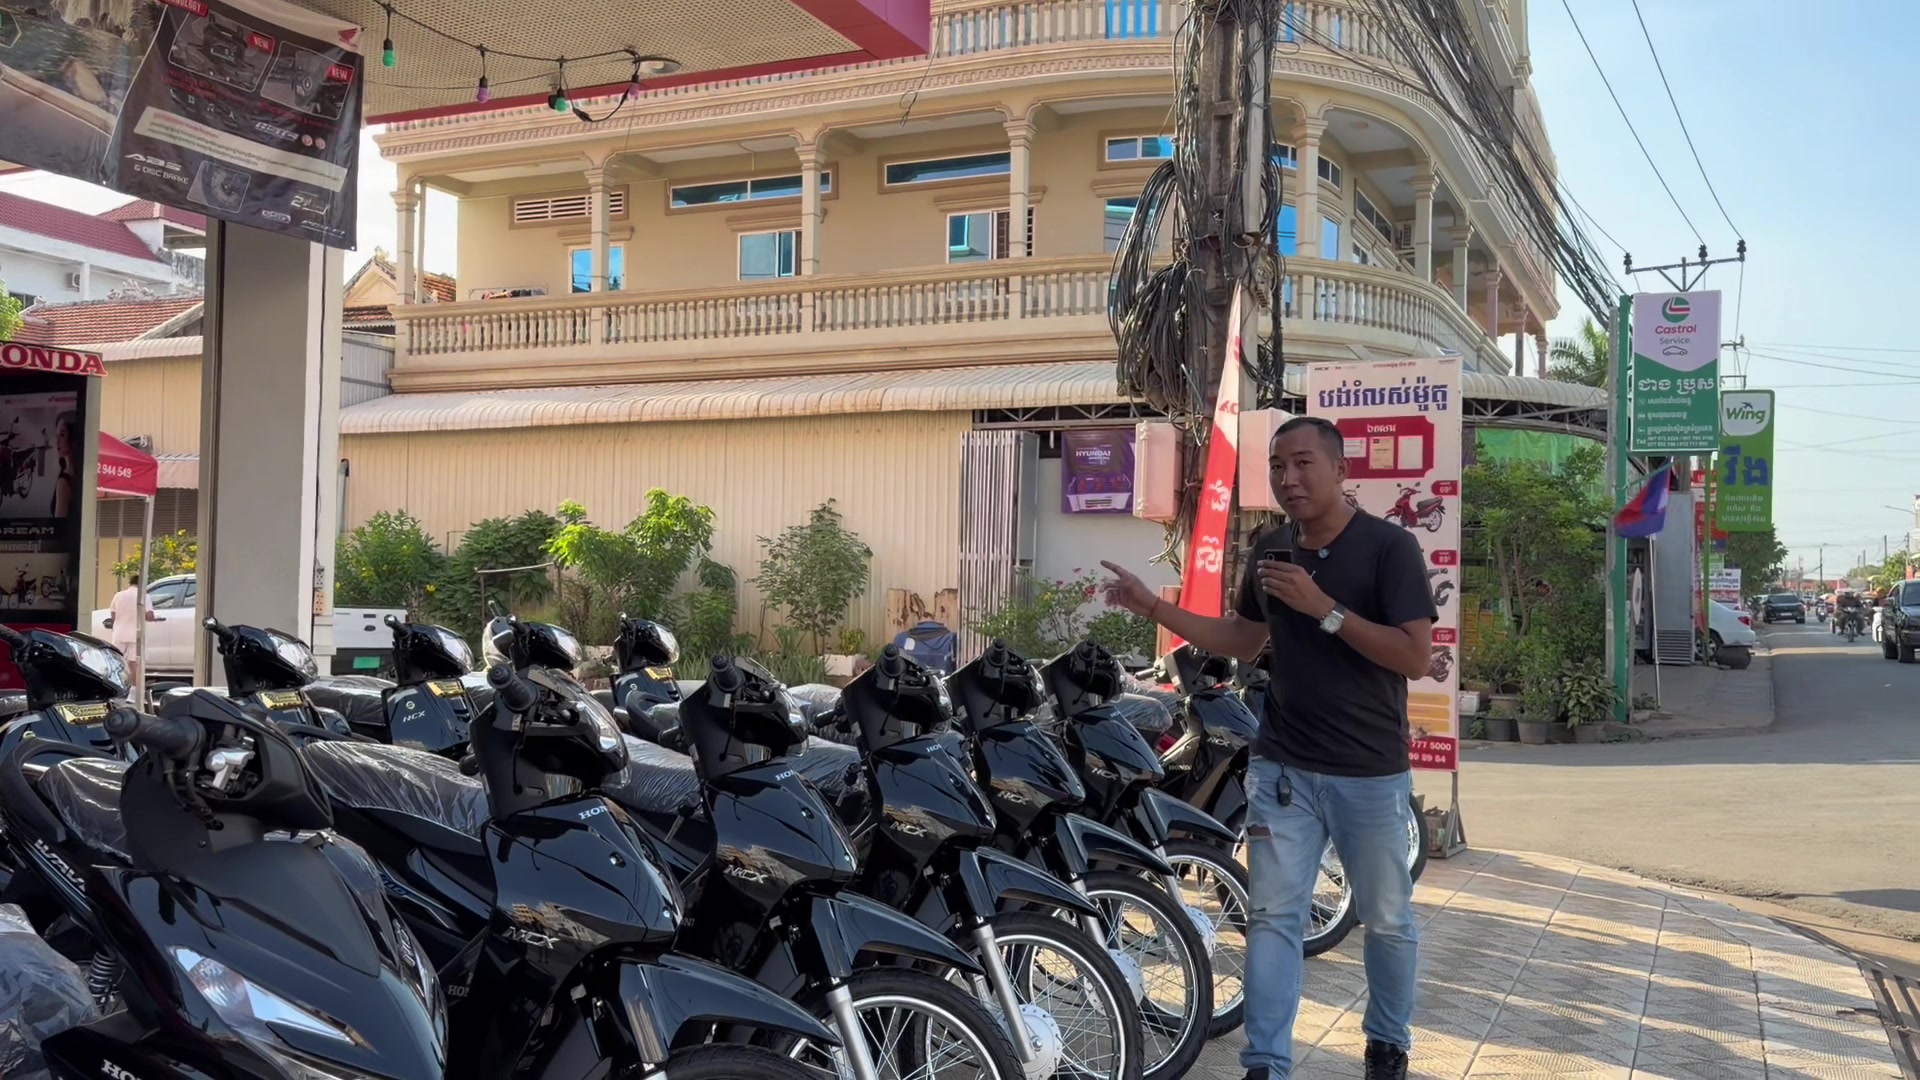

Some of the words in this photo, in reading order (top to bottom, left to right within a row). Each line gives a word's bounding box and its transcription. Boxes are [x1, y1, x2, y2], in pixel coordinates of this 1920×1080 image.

[254, 36, 269, 49] NEW
[331, 68, 347, 80] NEW
[142, 166, 162, 179] DISC
[163, 171, 189, 185] BRAKE
[1655, 325, 1697, 335] Castrol
[1659, 337, 1690, 345] Service
[0, 343, 108, 377] ONDA
[1725, 406, 1766, 425] Wing
[102, 464, 116, 476] 944
[0, 527, 55, 535] REAM
[403, 710, 426, 723] NCX
[1429, 741, 1451, 751] 5000
[890, 820, 928, 838] NCX
[723, 864, 769, 885] NCX
[502, 925, 561, 950] NCX
